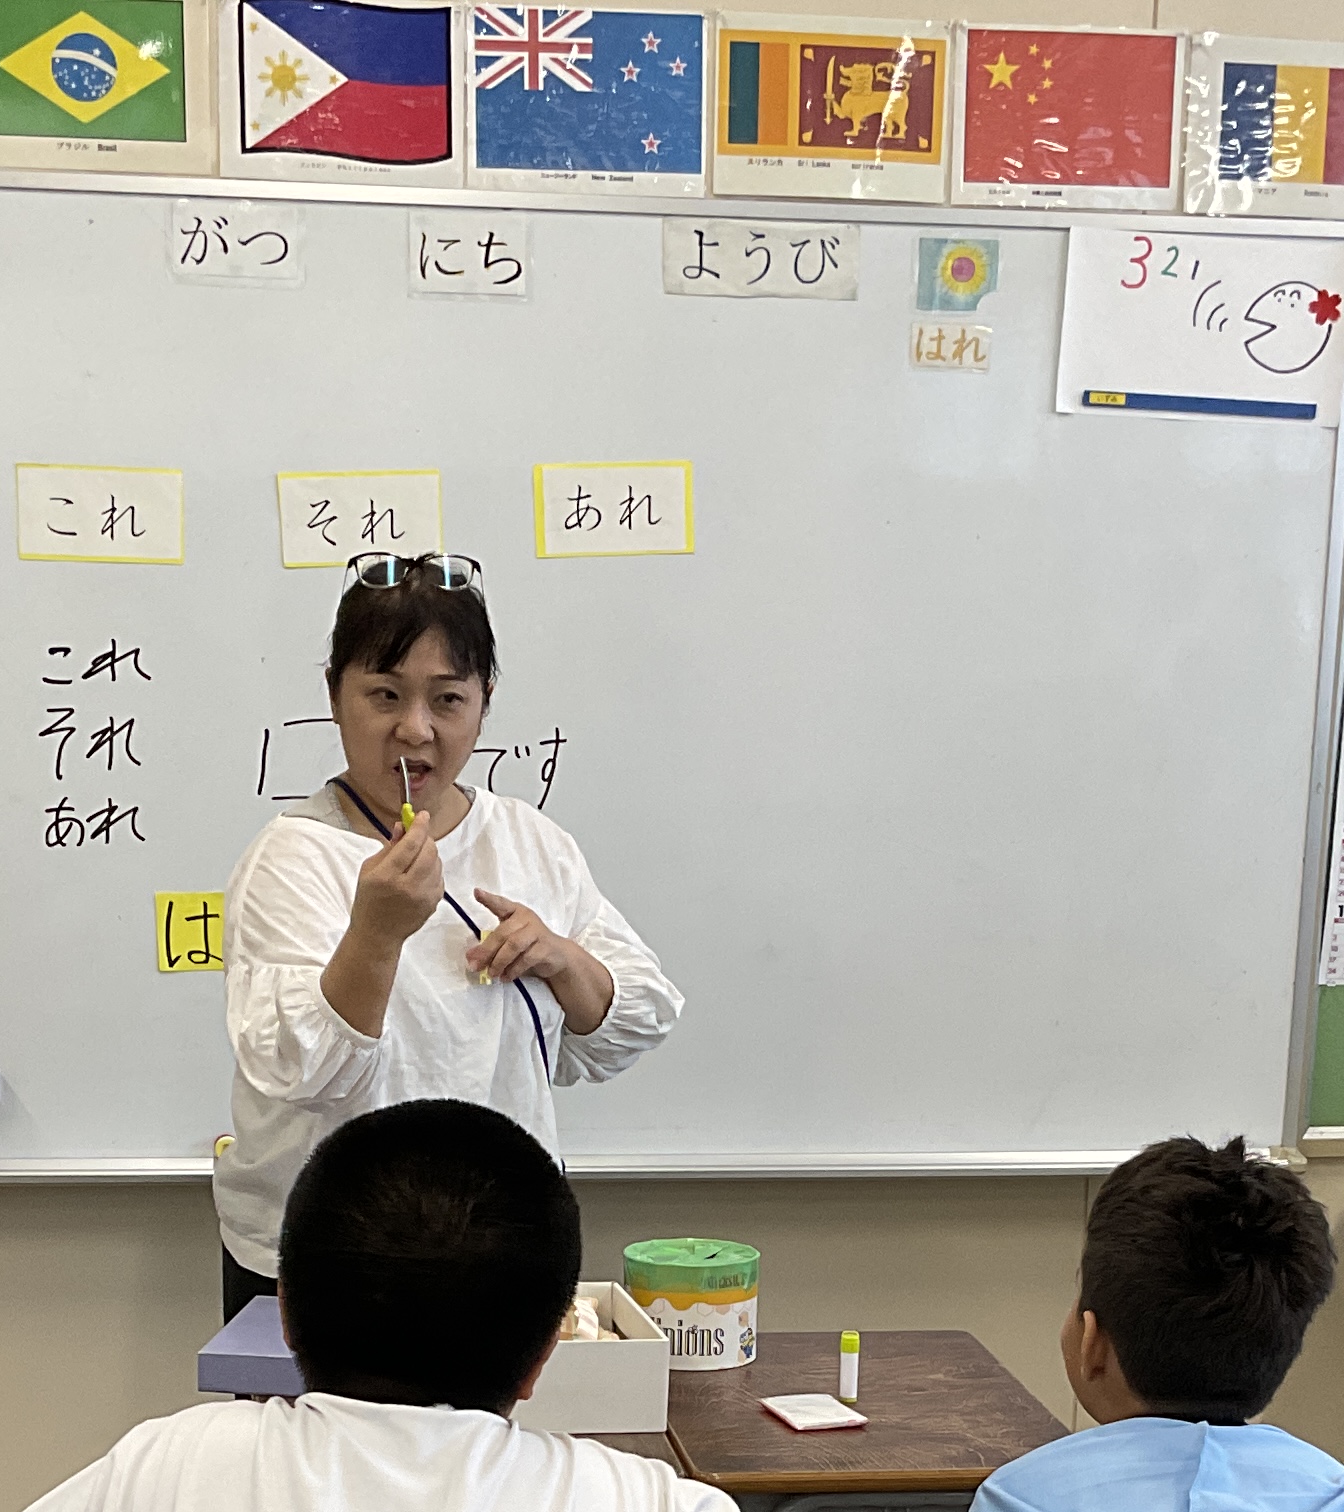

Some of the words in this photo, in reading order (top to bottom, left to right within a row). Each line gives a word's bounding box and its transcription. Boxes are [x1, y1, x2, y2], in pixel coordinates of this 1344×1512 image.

[747, 158, 783, 166] スリランカ
[179, 215, 291, 265] がつ
[417, 229, 524, 287] にち
[682, 233, 840, 286] ようび
[1120, 236, 1152, 289] 3
[1161, 246, 1179, 278] 2
[913, 329, 986, 366] はれ
[46, 495, 146, 539] これ
[307, 500, 405, 545] それ
[565, 488, 663, 532] あれ
[41, 640, 152, 686] これ
[39, 708, 141, 779] それ
[473, 727, 567, 809] です
[44, 798, 146, 848] あれ
[166, 900, 223, 967] は
[650, 1316, 725, 1357] nions
